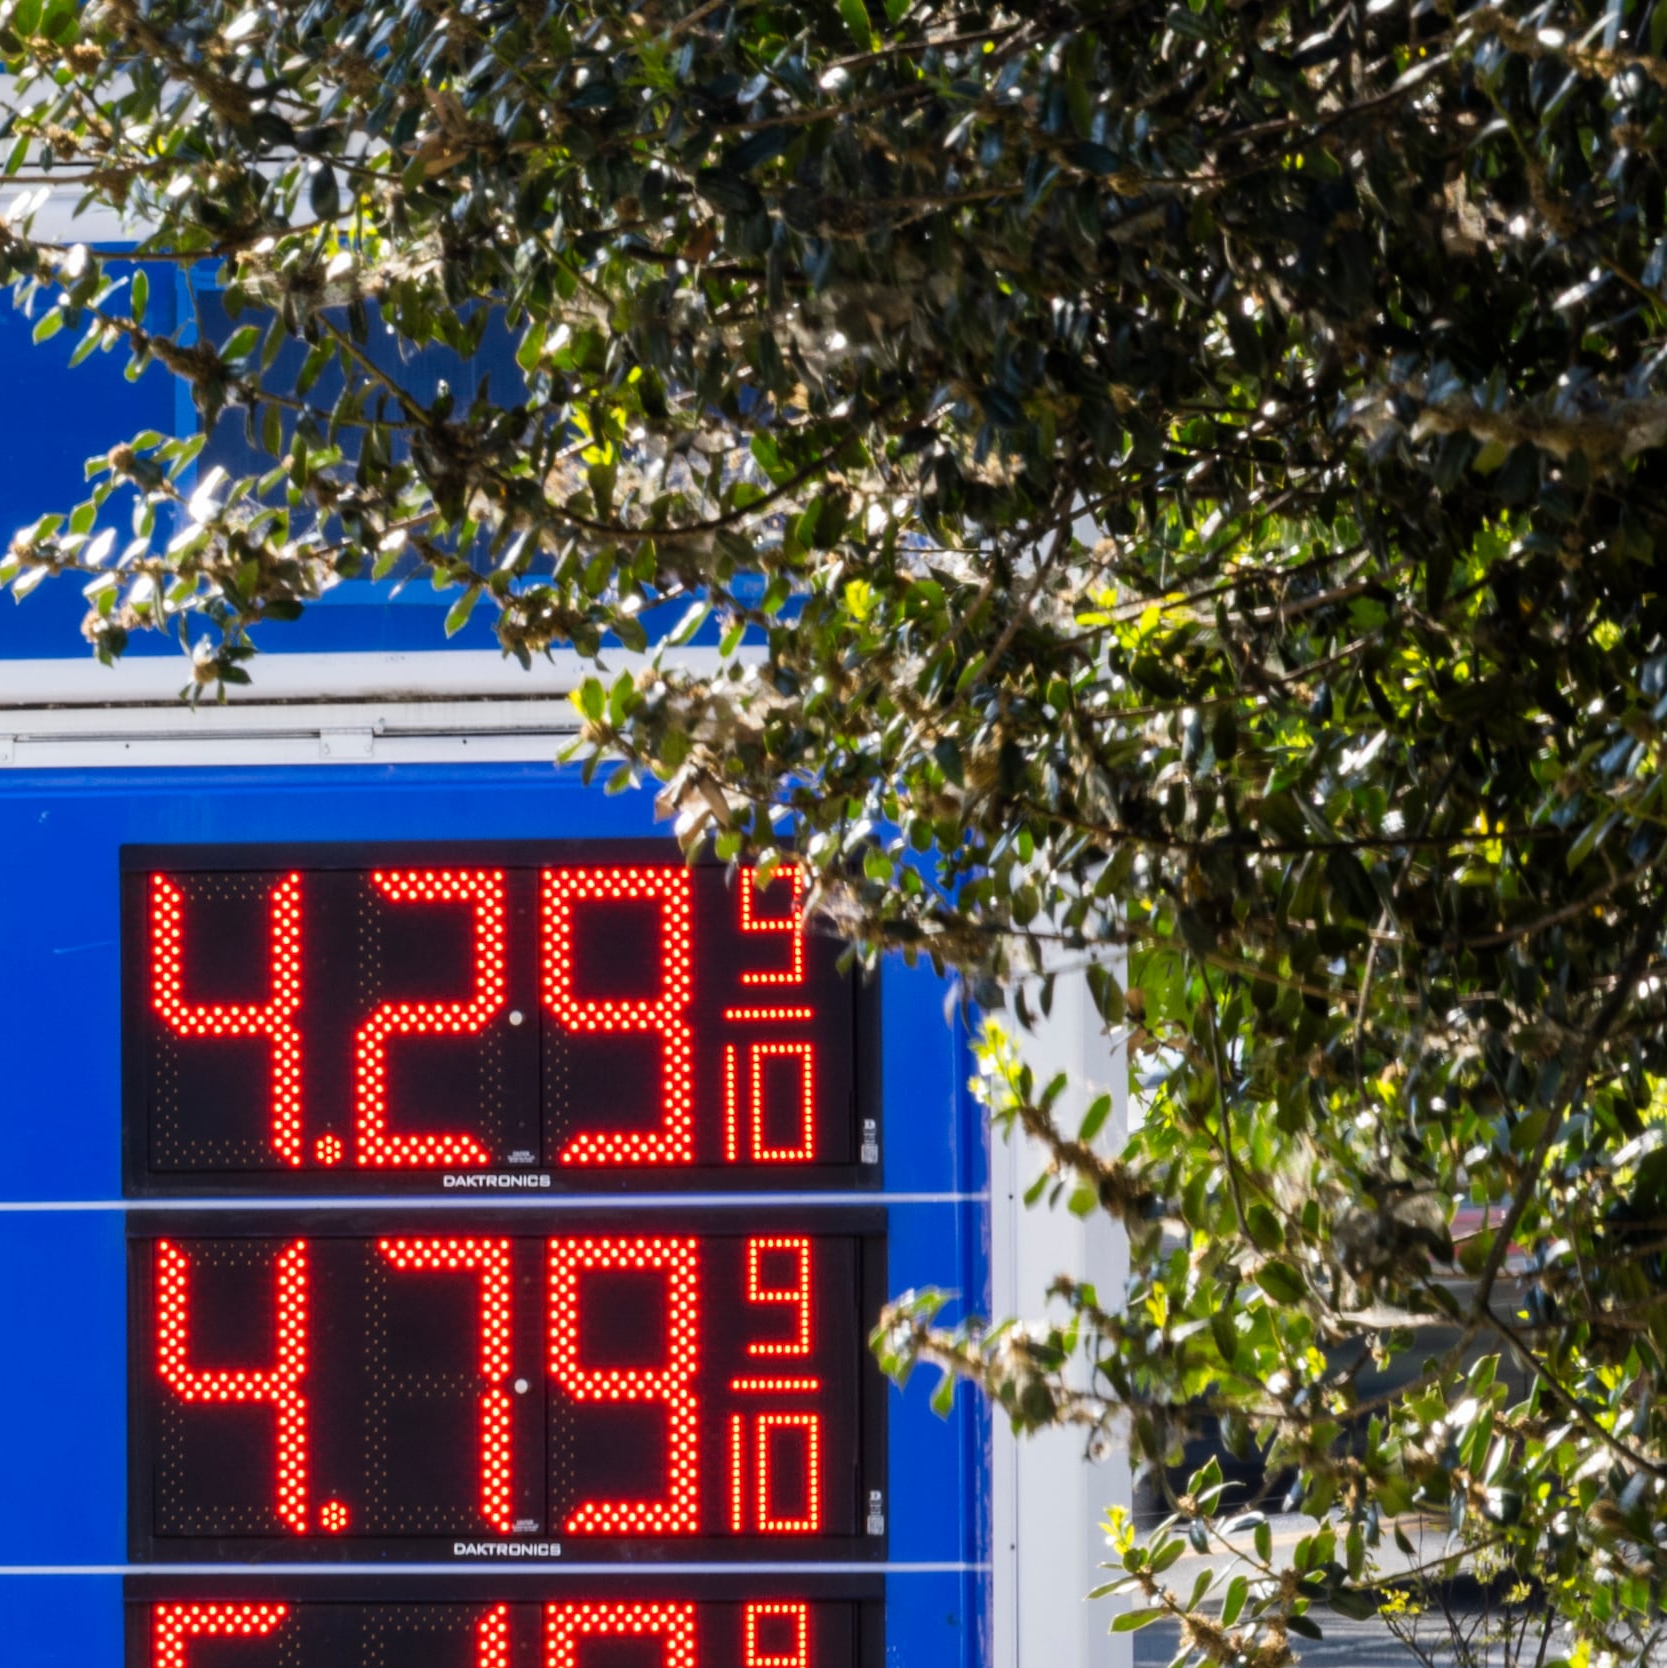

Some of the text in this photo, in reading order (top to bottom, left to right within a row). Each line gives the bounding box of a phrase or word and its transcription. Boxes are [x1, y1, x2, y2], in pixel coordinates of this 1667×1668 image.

[150, 866, 803, 1167] 4.29 9
[724, 1042, 816, 1162] 10
[443, 1174, 551, 1188] DAKTRONICS
[155, 1237, 811, 1535] 4.79 9
[729, 1413, 822, 1534] 10
[453, 1542, 562, 1557] DAKTRONICS
